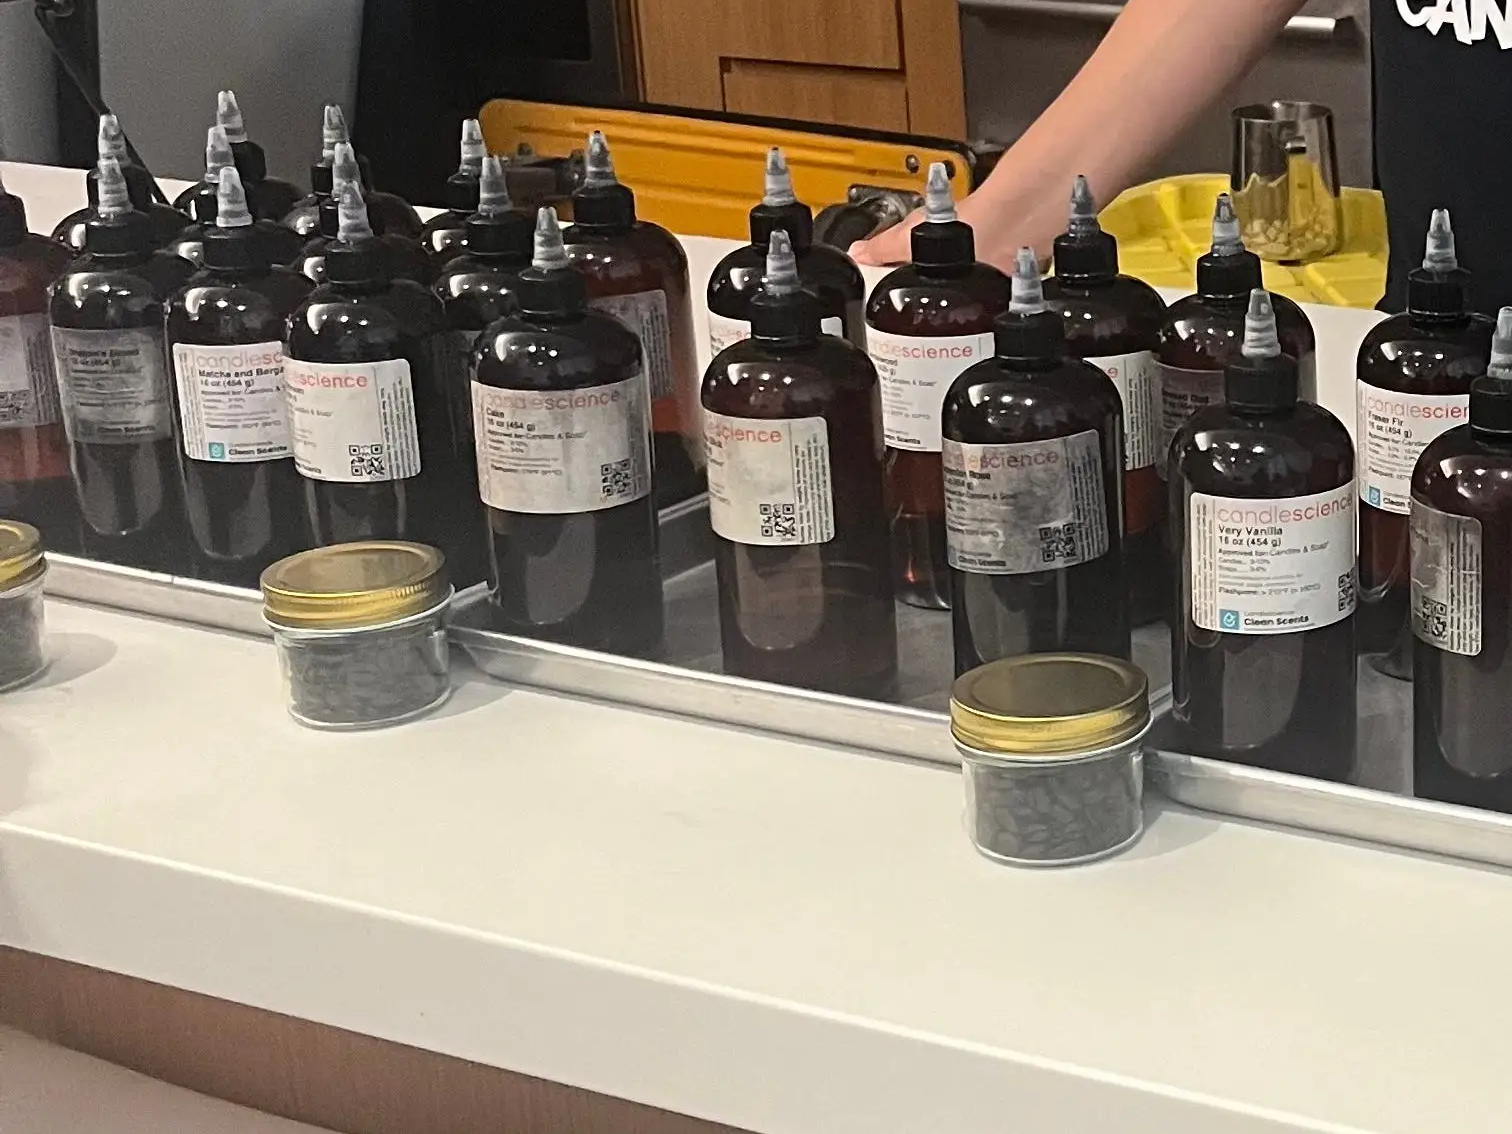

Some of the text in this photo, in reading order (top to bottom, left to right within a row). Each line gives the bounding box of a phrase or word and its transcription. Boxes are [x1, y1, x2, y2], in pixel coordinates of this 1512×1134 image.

[1217, 494, 1354, 525] candlescience
[1218, 524, 1283, 537] Very Vanilla
[1244, 615, 1309, 626] Clean Scents
